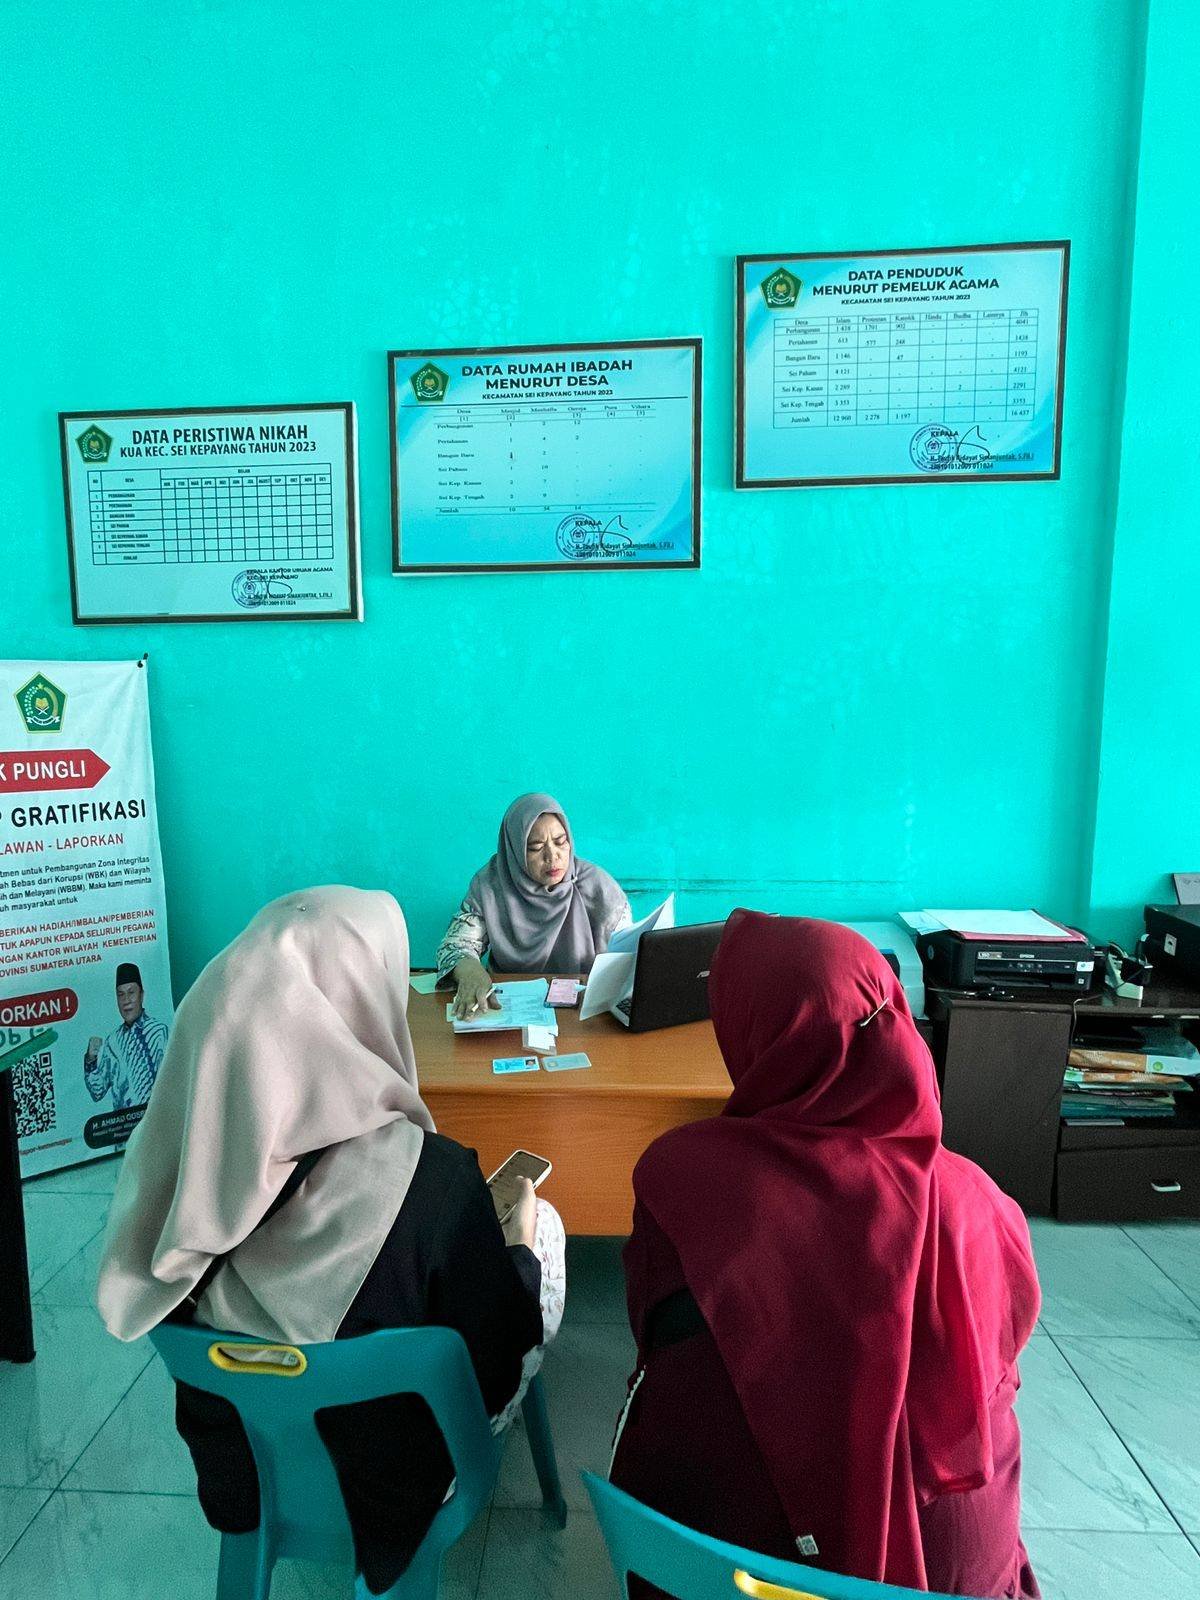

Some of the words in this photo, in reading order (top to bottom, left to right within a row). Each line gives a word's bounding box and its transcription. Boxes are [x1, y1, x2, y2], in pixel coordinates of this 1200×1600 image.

[848, 270, 884, 281] DATA
[887, 266, 964, 279] PENDUDUK
[812, 283, 878, 296] MENURUT
[882, 280, 946, 293] PEMELUK
[948, 278, 1000, 290] AGAMA
[895, 295, 930, 303] KEPAYANG
[461, 364, 503, 377] DATA
[507, 362, 566, 375] RUMAH
[570, 359, 633, 373] IBADAH
[486, 376, 563, 389] MENURUT
[567, 374, 609, 387] DESA
[482, 392, 523, 400] KECAMATAN
[536, 390, 572, 398] KEPAYANG
[132, 429, 169, 445] DATA
[173, 426, 256, 444] PERISTIWA
[259, 424, 308, 441] NIKAH
[120, 446, 143, 458] KUA
[145, 445, 169, 457] KEC.
[170, 445, 187, 456] SEI
[190, 443, 246, 456] KEPAYANG
[248, 441, 287, 453] TAHUN
[289, 441, 317, 452] 2023
[575, 519, 602, 527] KEPALA
[13, 760, 86, 781] PUNGLI
[11, 798, 146, 828] GRATIFIKASI
[56, 832, 124, 850] LAPORKAN
[21, 867, 43, 875] untuk
[45, 862, 96, 873] Pembangunan
[117, 856, 150, 865] Integritas
[11, 880, 36, 888] Bebas
[38, 877, 53, 885] dari
[55, 873, 83, 883] Korupsi
[85, 870, 107, 881] (WBK)
[124, 866, 151, 876] Wilayah
[9, 892, 23, 900] dan
[25, 888, 56, 898] Melayani
[57, 883, 87, 895] (WBBM).
[89, 882, 106, 890] Maka
[108, 880, 123, 888] kami
[124, 877, 152, 885] meminta
[11, 898, 56, 911] masyarakat
[57, 895, 79, 905] untuk
[19, 936, 52, 948] APAPUN
[54, 931, 84, 943] KEPADA
[86, 925, 121, 938] SELURUH
[123, 921, 155, 933] PEGAWAI
[26, 947, 61, 960] KANTOR
[63, 942, 98, 954] WILAYAH
[102, 933, 157, 948] KEMENTERIAN
[30, 958, 74, 973] SUMATERA
[76, 954, 102, 965] UTARA
[0, 999, 61, 1025] ORKAN
[101, 1115, 126, 1127] AHMAD
